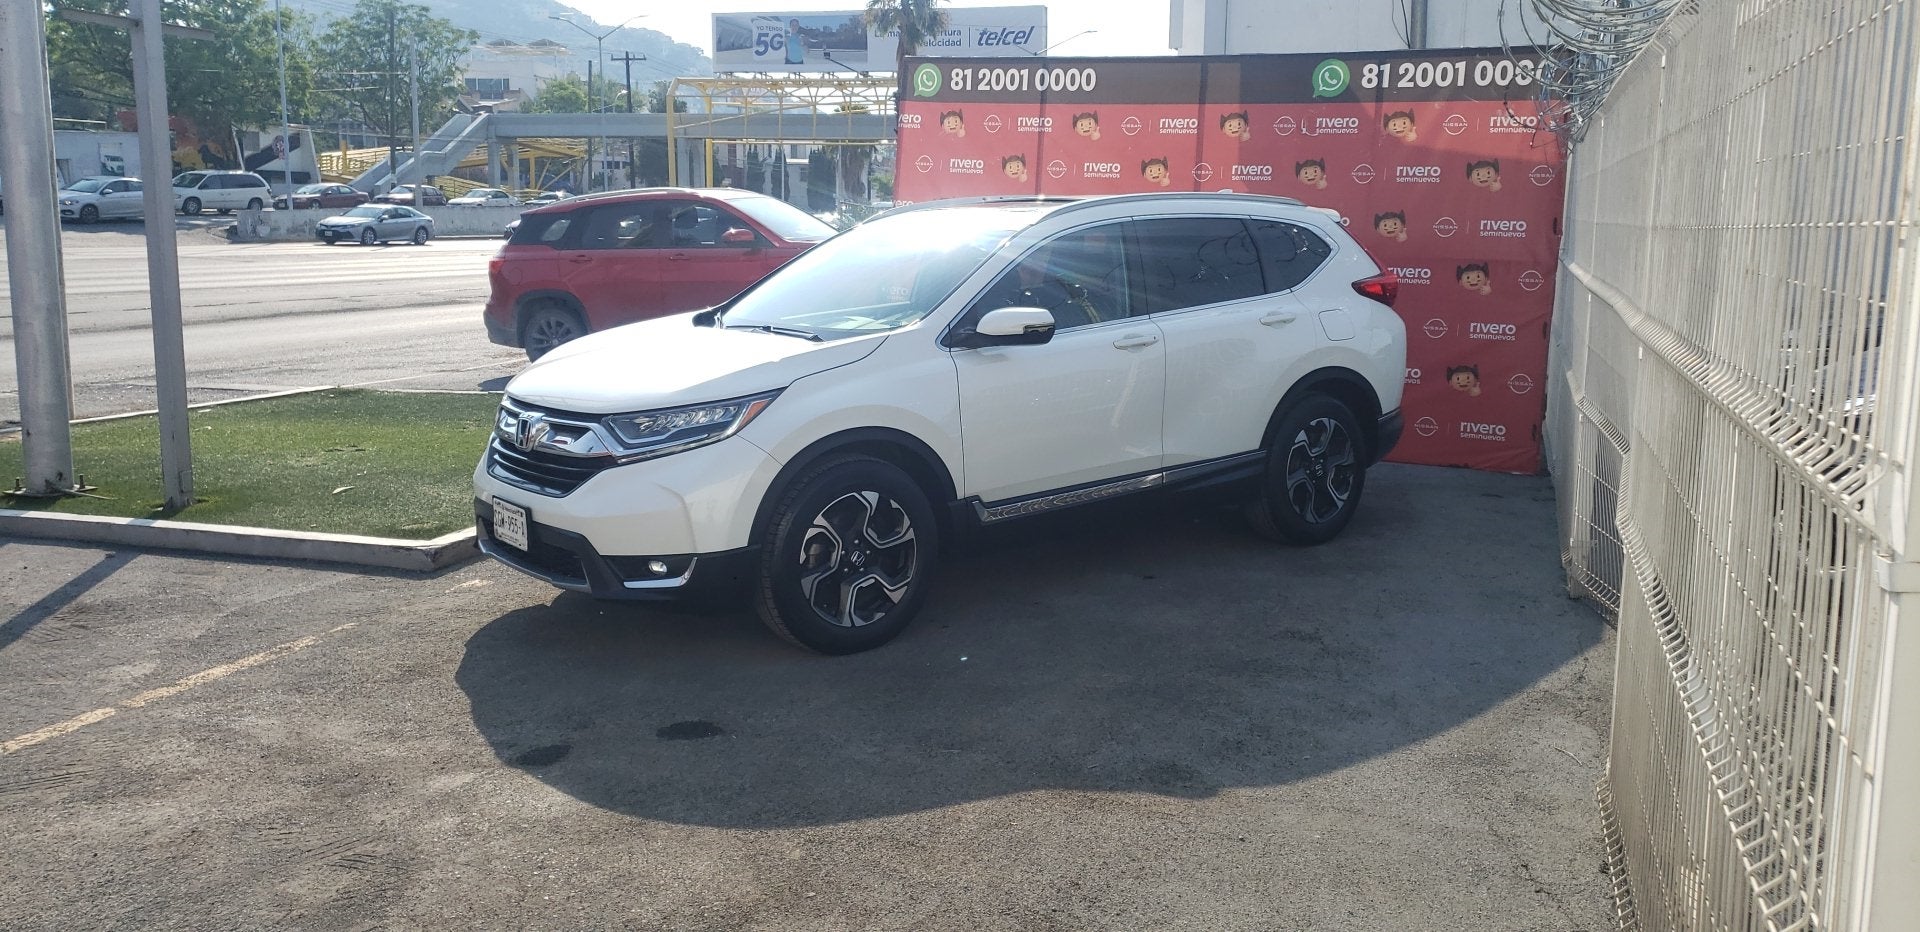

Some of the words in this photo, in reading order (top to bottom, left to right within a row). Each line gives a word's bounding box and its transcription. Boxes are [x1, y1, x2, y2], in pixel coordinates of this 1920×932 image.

[978, 25, 1035, 46] telcel
[754, 32, 784, 56] 5G
[951, 68, 972, 91] 81
[978, 68, 1029, 91] 2001
[1035, 68, 1096, 91] 0000
[1361, 64, 1391, 88] 81
[1398, 61, 1466, 88] 2001
[1017, 117, 1052, 127] rivero
[1160, 118, 1198, 128] rivero
[1316, 117, 1359, 128] rivero
[1489, 115, 1537, 127] rivero
[950, 158, 984, 168] rivero
[1084, 162, 1120, 172] rivero
[1231, 165, 1272, 175] rivero
[1396, 165, 1441, 177] rivero
[1480, 219, 1526, 231] rivero
[1470, 322, 1516, 334] rivero
[1469, 333, 1516, 341] seminuevos
[1460, 421, 1506, 435] rivero
[1460, 432, 1505, 441] seminuevos
